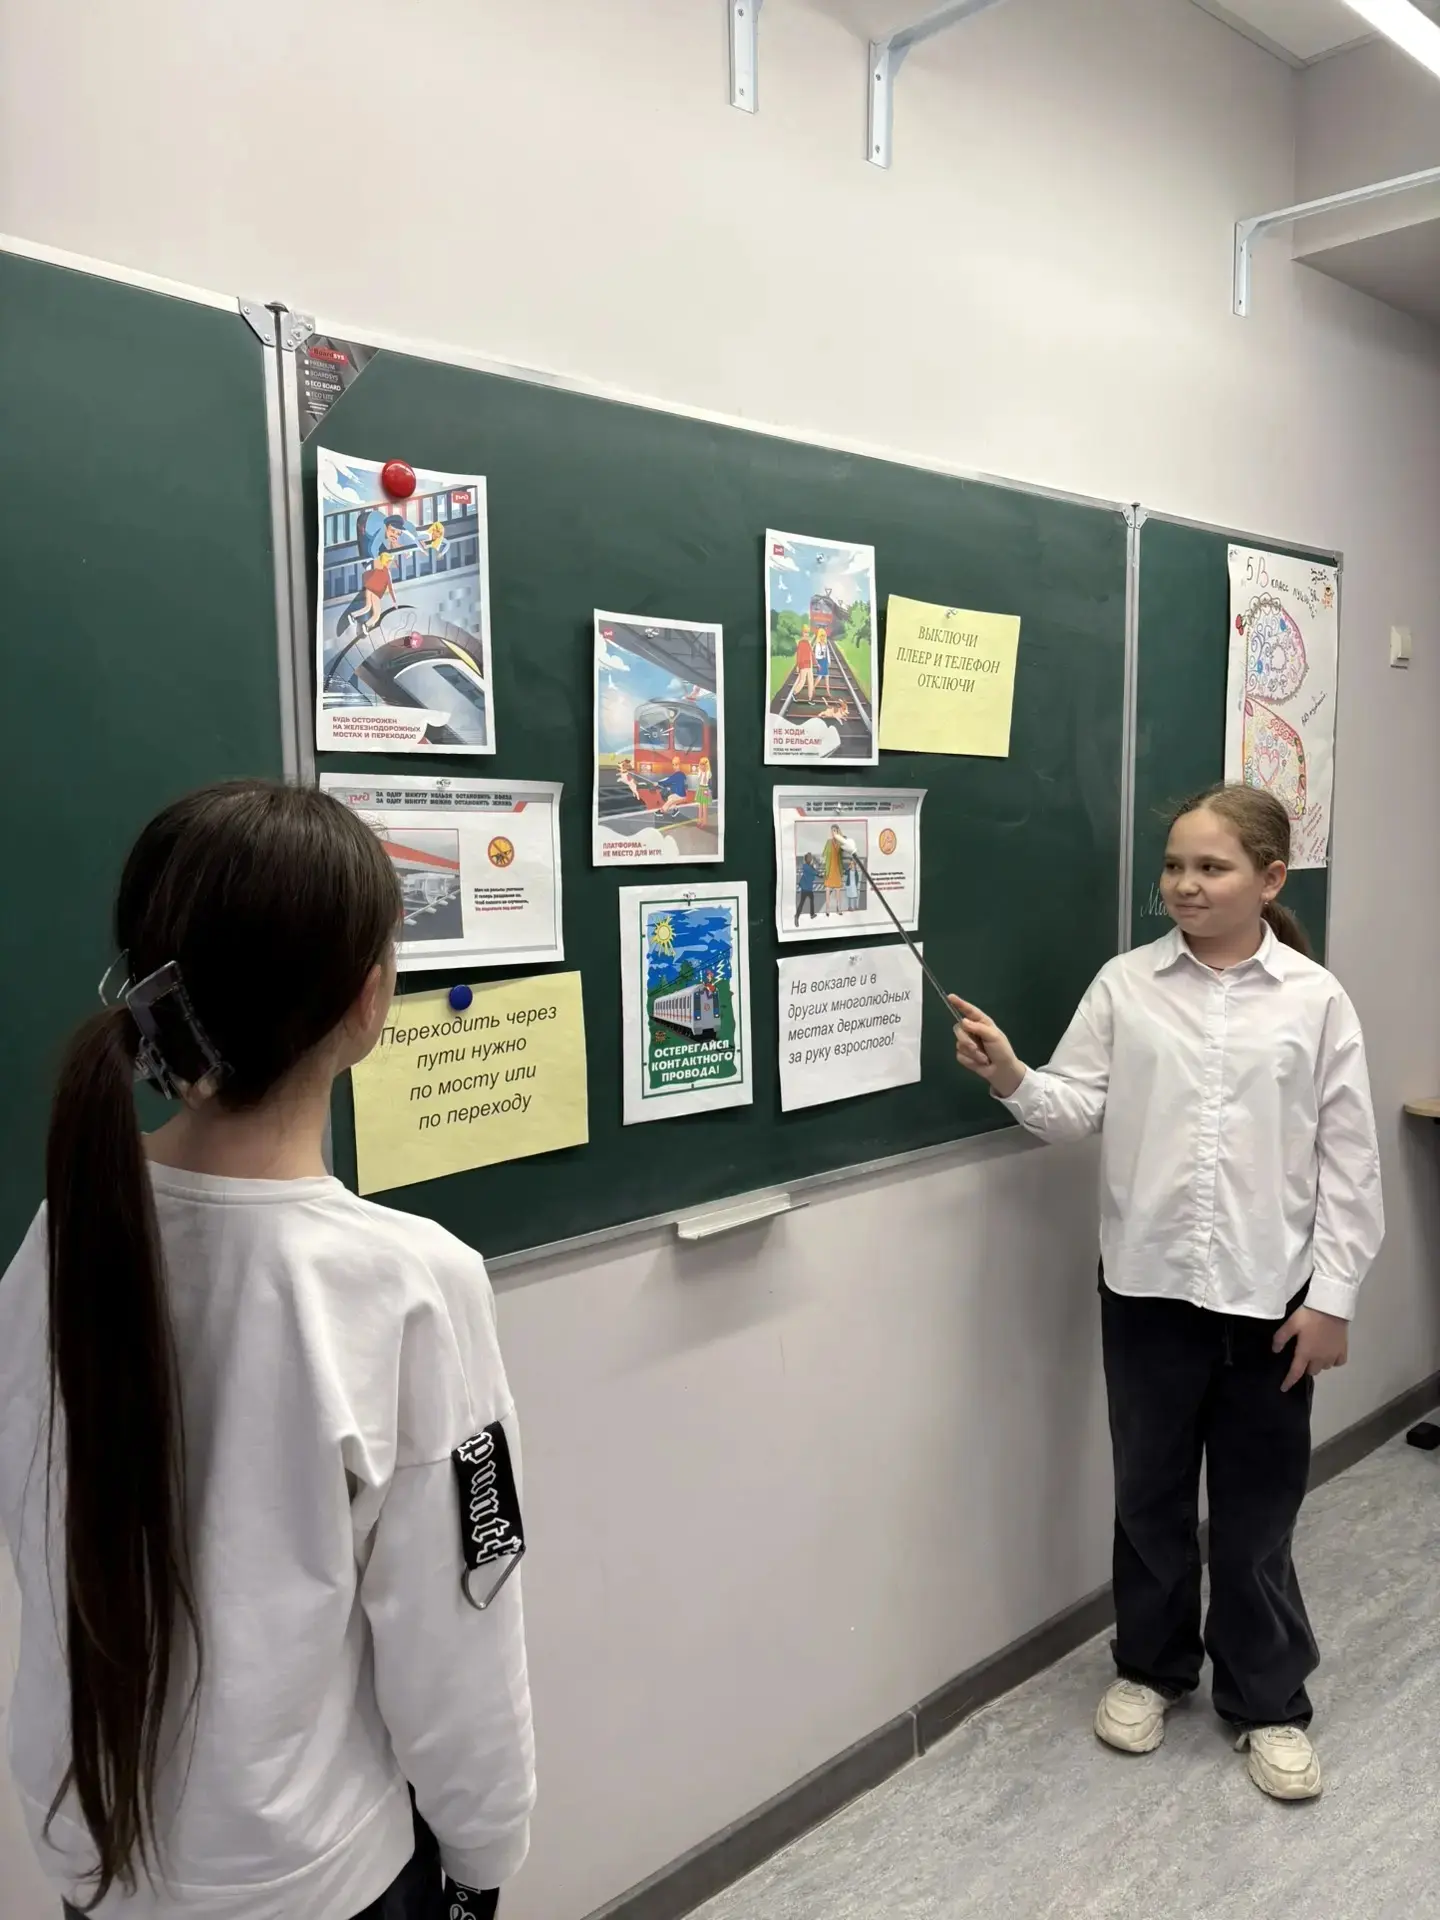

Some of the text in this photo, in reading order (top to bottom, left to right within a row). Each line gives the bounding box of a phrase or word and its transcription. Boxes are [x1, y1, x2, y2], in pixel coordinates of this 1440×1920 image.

[311, 381, 342, 392] ECO BOARD
[917, 625, 979, 648] ВЫКЛЮЧИ
[896, 646, 1000, 674] ПЛЕЕР И ТЕЛЕФОН
[917, 673, 976, 693] ОТКЛЮЧИ
[332, 731, 363, 739] МОСТАХ
[343, 724, 421, 732] ЖЕЛЕЗНОДОРОЖНЫХ
[784, 728, 805, 736] ХОДИ
[634, 849, 648, 857] ДЛЯ
[790, 973, 877, 995] На вокзале и в
[787, 989, 911, 1021] других многолюдных
[380, 1006, 557, 1046] Переходить через
[787, 1013, 902, 1042] местах держитесь
[417, 1037, 527, 1071] пути нужно
[654, 1038, 730, 1059] ОСТЕРЕГАЙСЯ
[788, 1031, 895, 1064] за руку взрослого!
[651, 1051, 734, 1072] КОНТАКТНОГО
[409, 1065, 537, 1101] по мосту или
[661, 1065, 720, 1083] ПРОВОДА!
[418, 1092, 533, 1130] по переходу
